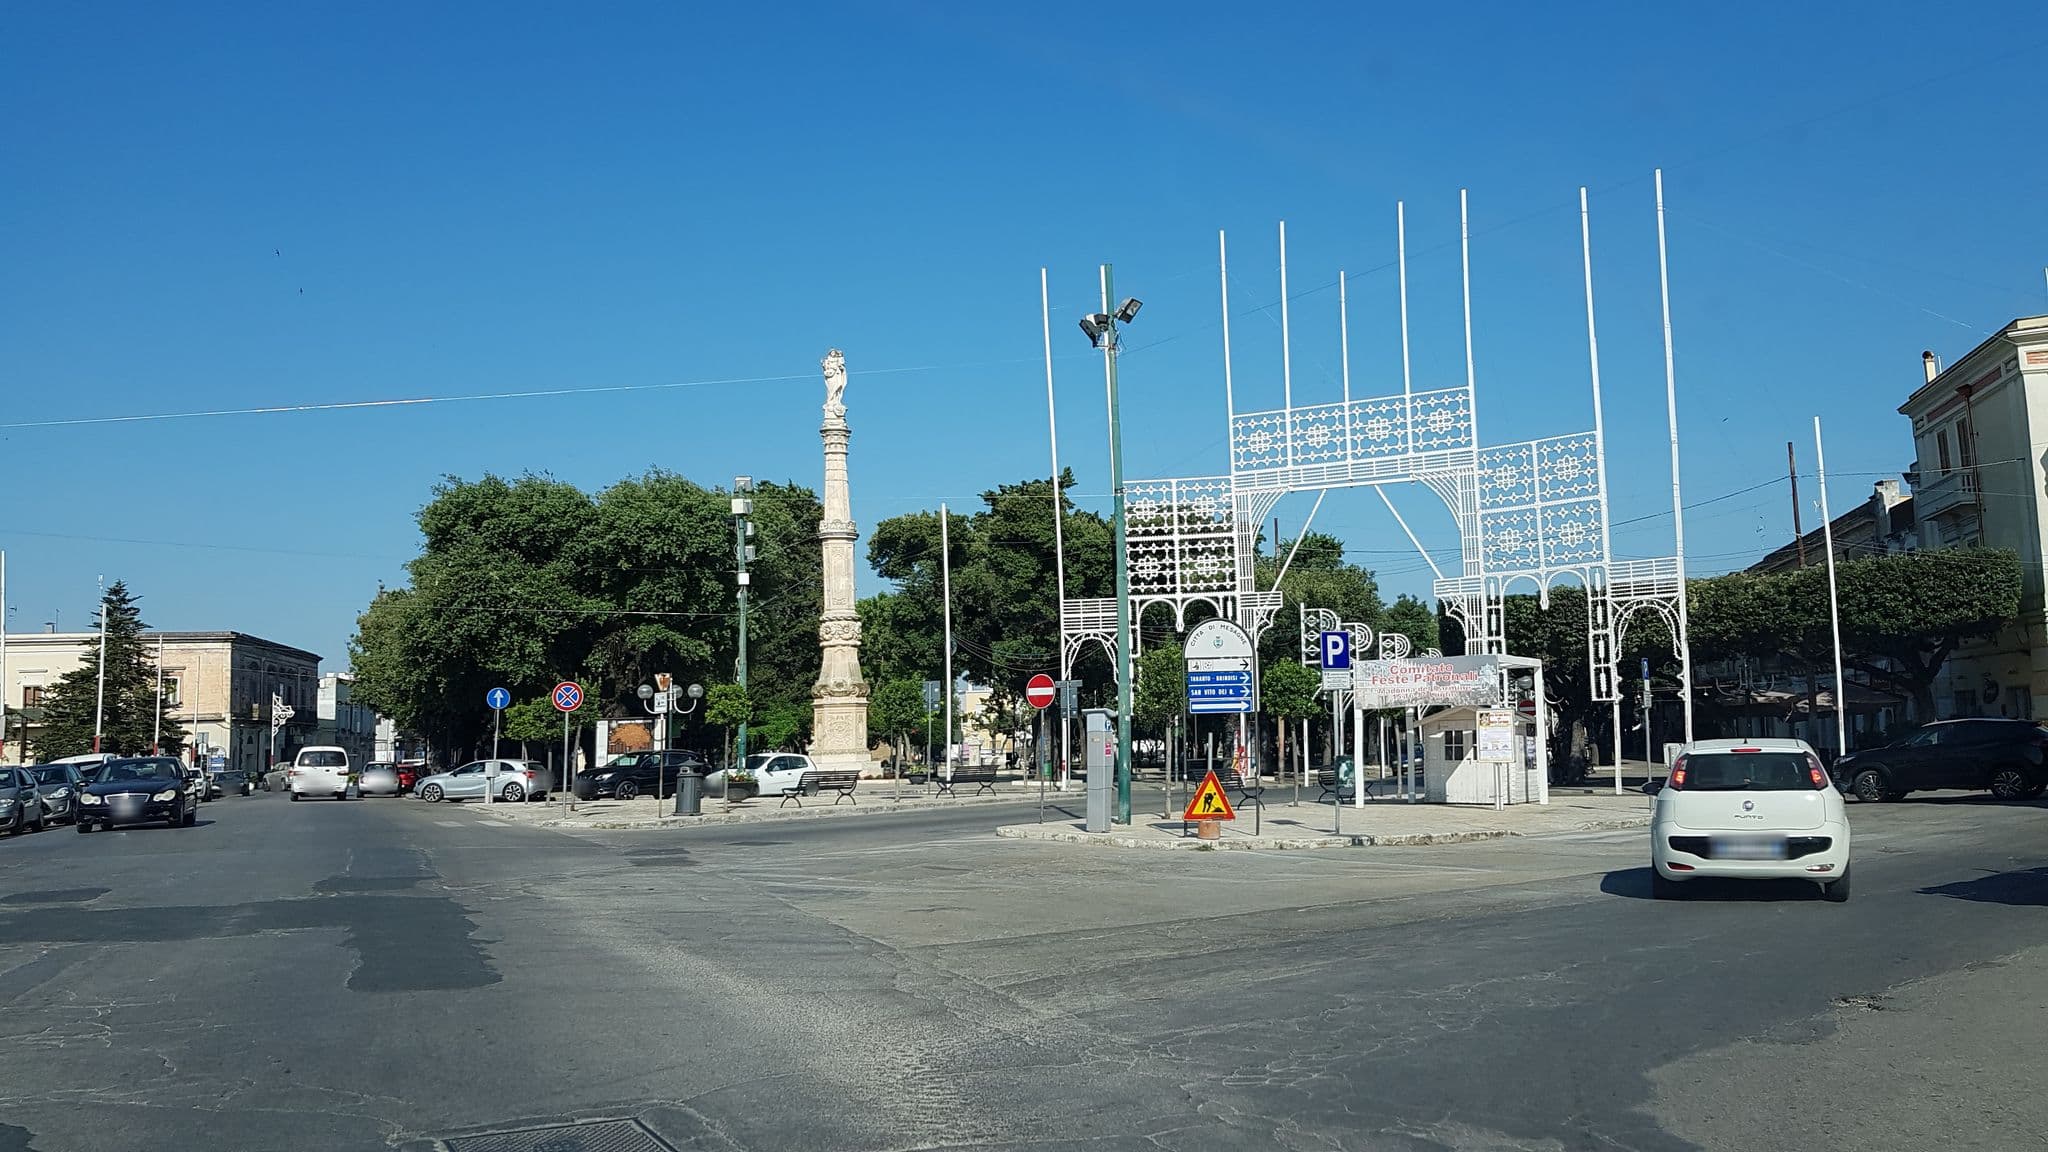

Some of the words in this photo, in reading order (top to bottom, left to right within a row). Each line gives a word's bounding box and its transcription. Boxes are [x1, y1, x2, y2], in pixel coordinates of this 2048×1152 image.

[1220, 624, 1247, 645] MESAGNE
[1326, 634, 1345, 666] P
[1390, 663, 1453, 675] Comitato
[1371, 675, 1409, 685] Feste
[1414, 670, 1478, 683] Patronali
[1204, 688, 1216, 696] VITO
